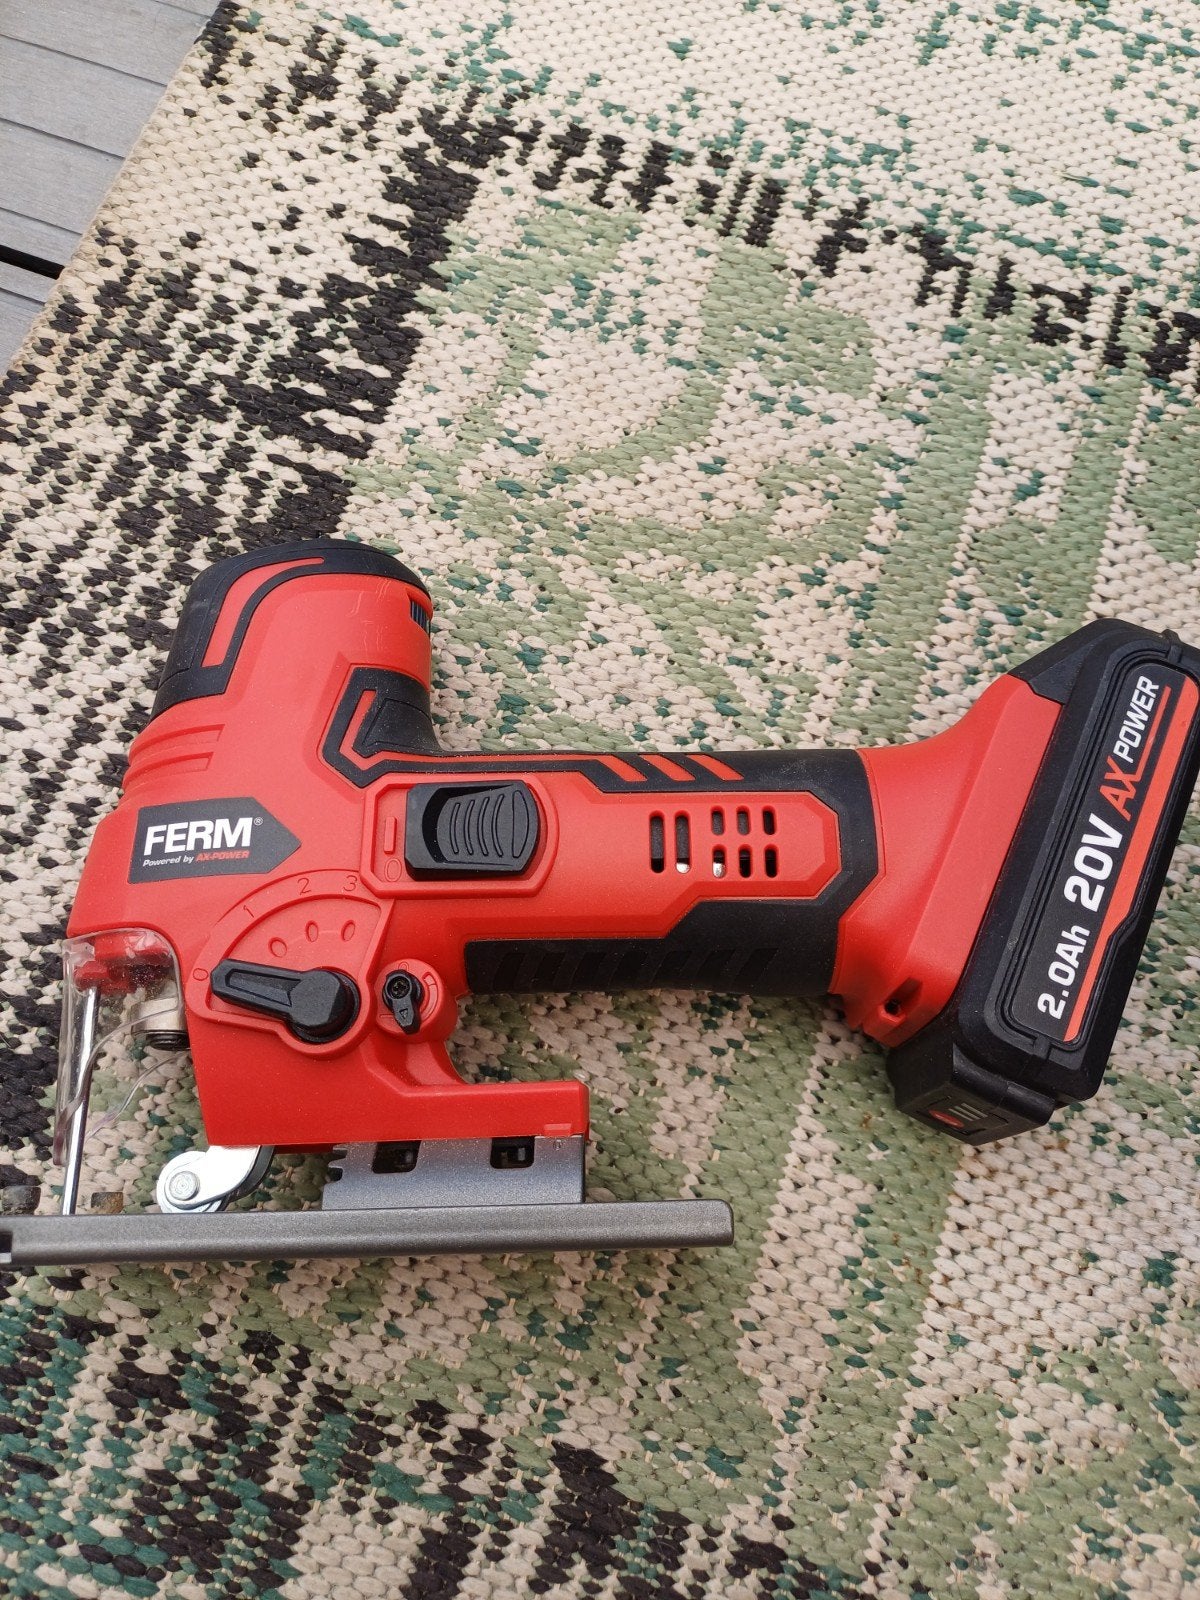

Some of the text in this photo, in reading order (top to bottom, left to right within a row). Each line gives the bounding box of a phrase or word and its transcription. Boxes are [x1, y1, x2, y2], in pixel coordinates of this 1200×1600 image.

[142, 855, 182, 867] Powered
[182, 854, 195, 864] by
[296, 876, 312, 895] 2
[341, 874, 358, 892] 3
[1037, 925, 1090, 1020] 2.0Ah
[1064, 813, 1124, 912] 20V
